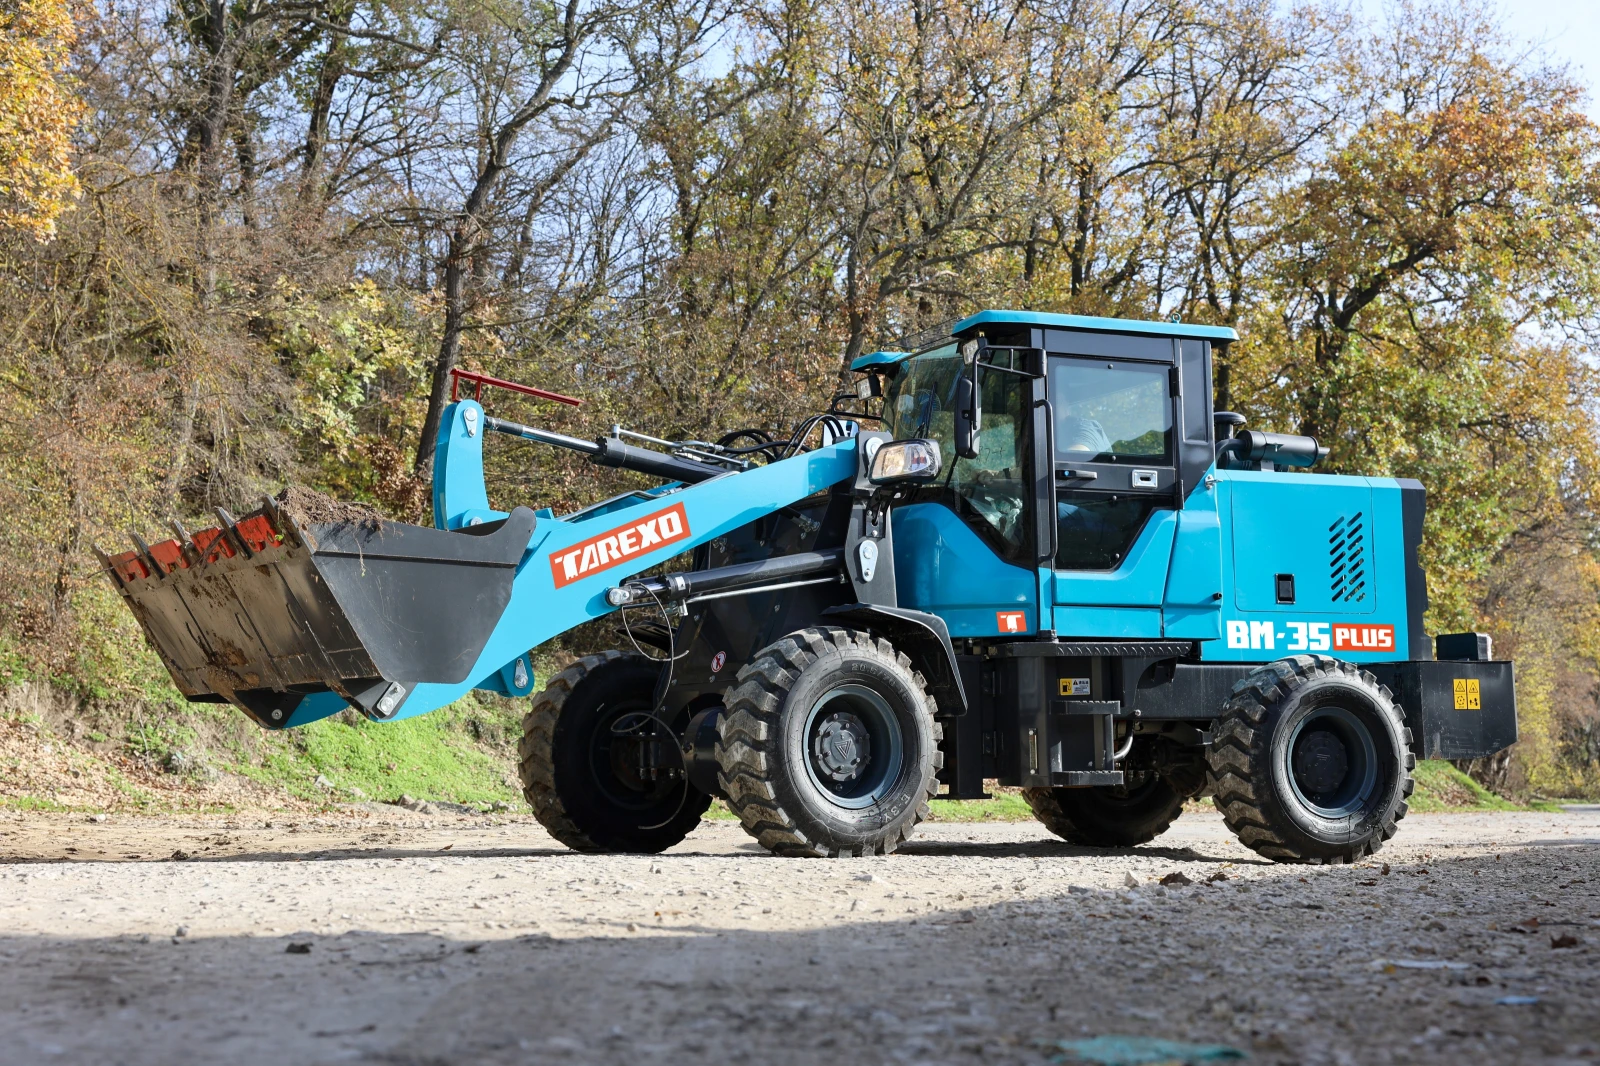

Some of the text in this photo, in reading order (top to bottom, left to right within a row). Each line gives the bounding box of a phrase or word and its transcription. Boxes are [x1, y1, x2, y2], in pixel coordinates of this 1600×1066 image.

[554, 510, 683, 581] TAREXO
[1000, 614, 1022, 631] T
[1226, 620, 1392, 651] BM-35 PLUS
